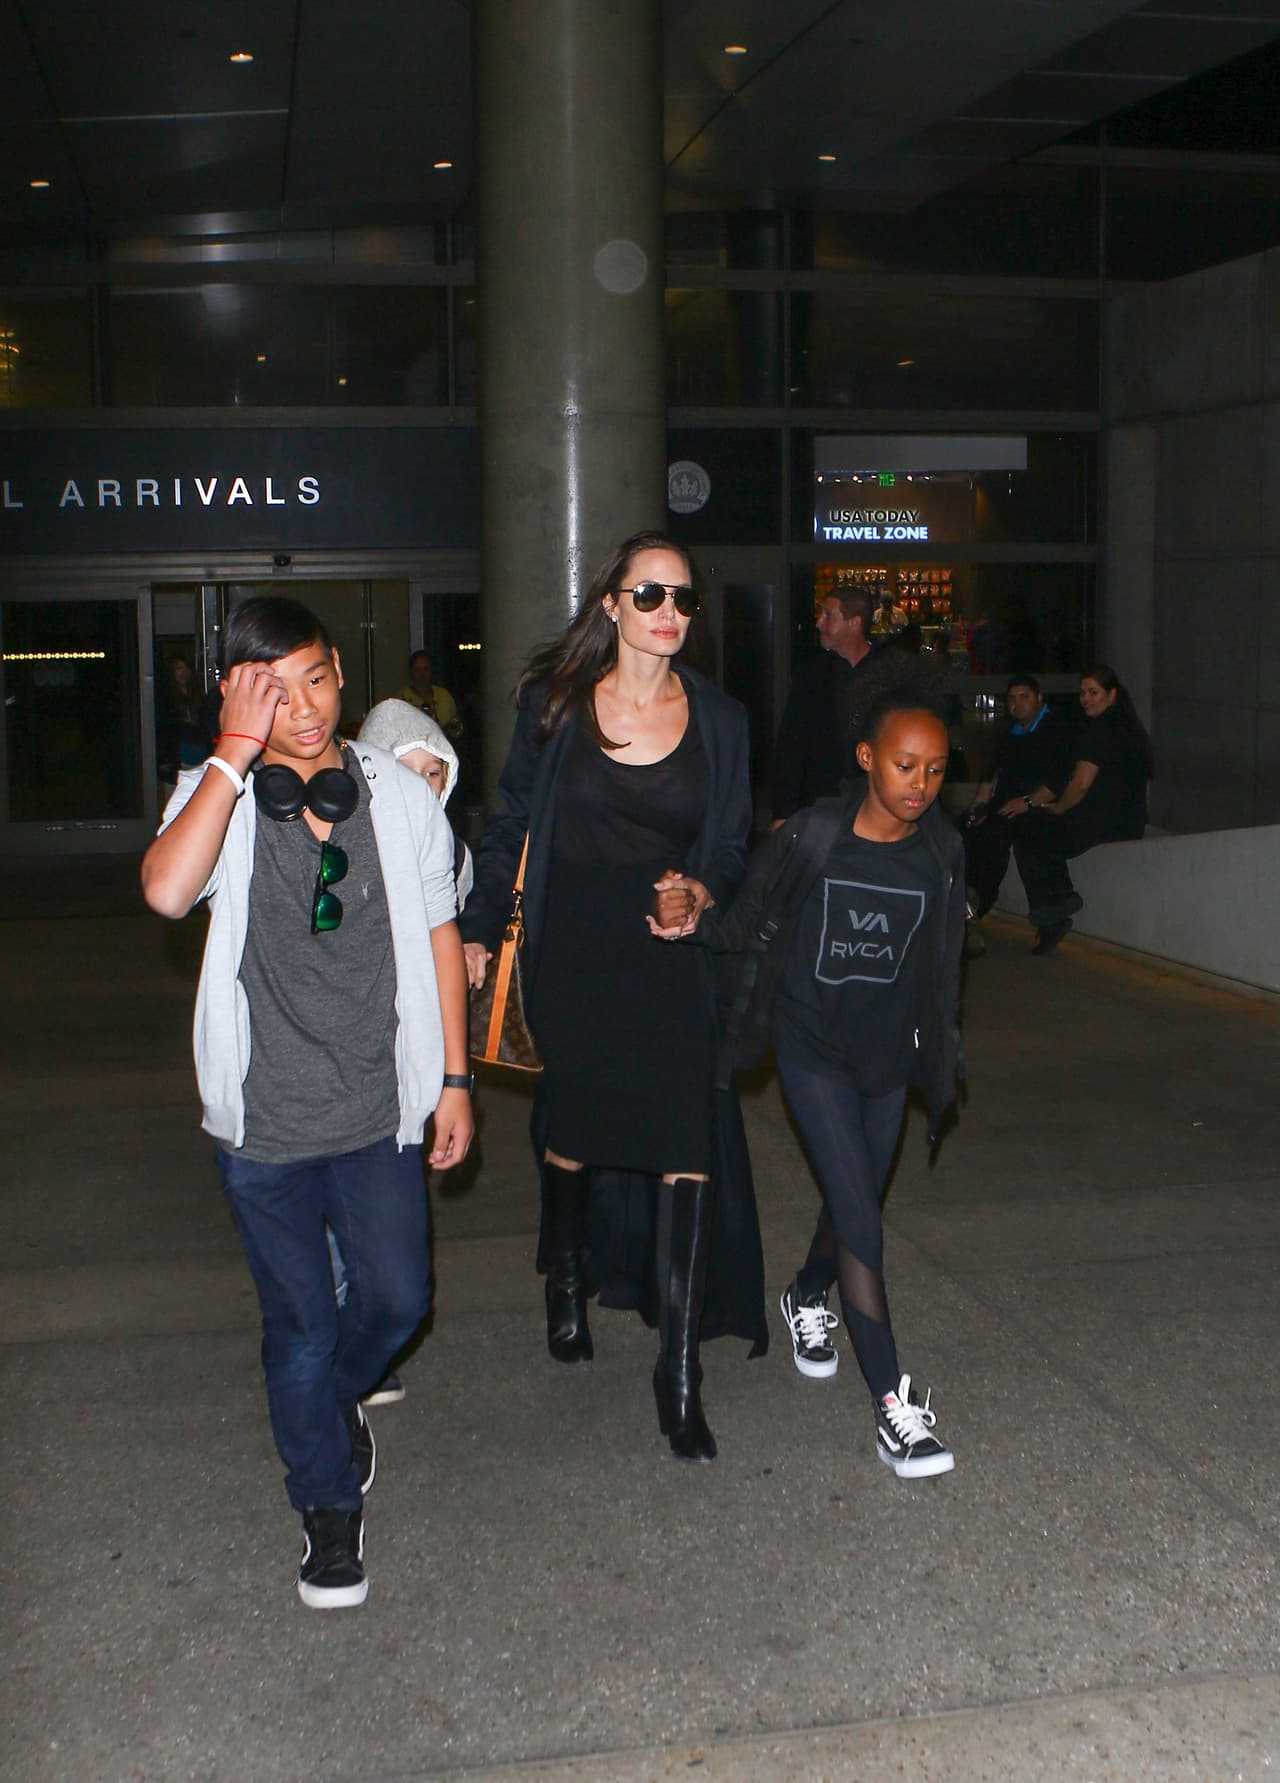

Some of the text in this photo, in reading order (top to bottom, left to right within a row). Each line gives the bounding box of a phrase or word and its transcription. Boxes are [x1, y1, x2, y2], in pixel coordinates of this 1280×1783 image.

[59, 477, 320, 507] ARRIVALS
[829, 509, 919, 523] USA TODAY
[823, 526, 929, 540] TRAVEL ZONE
[848, 909, 889, 934] VA
[830, 940, 894, 961] RVCA
